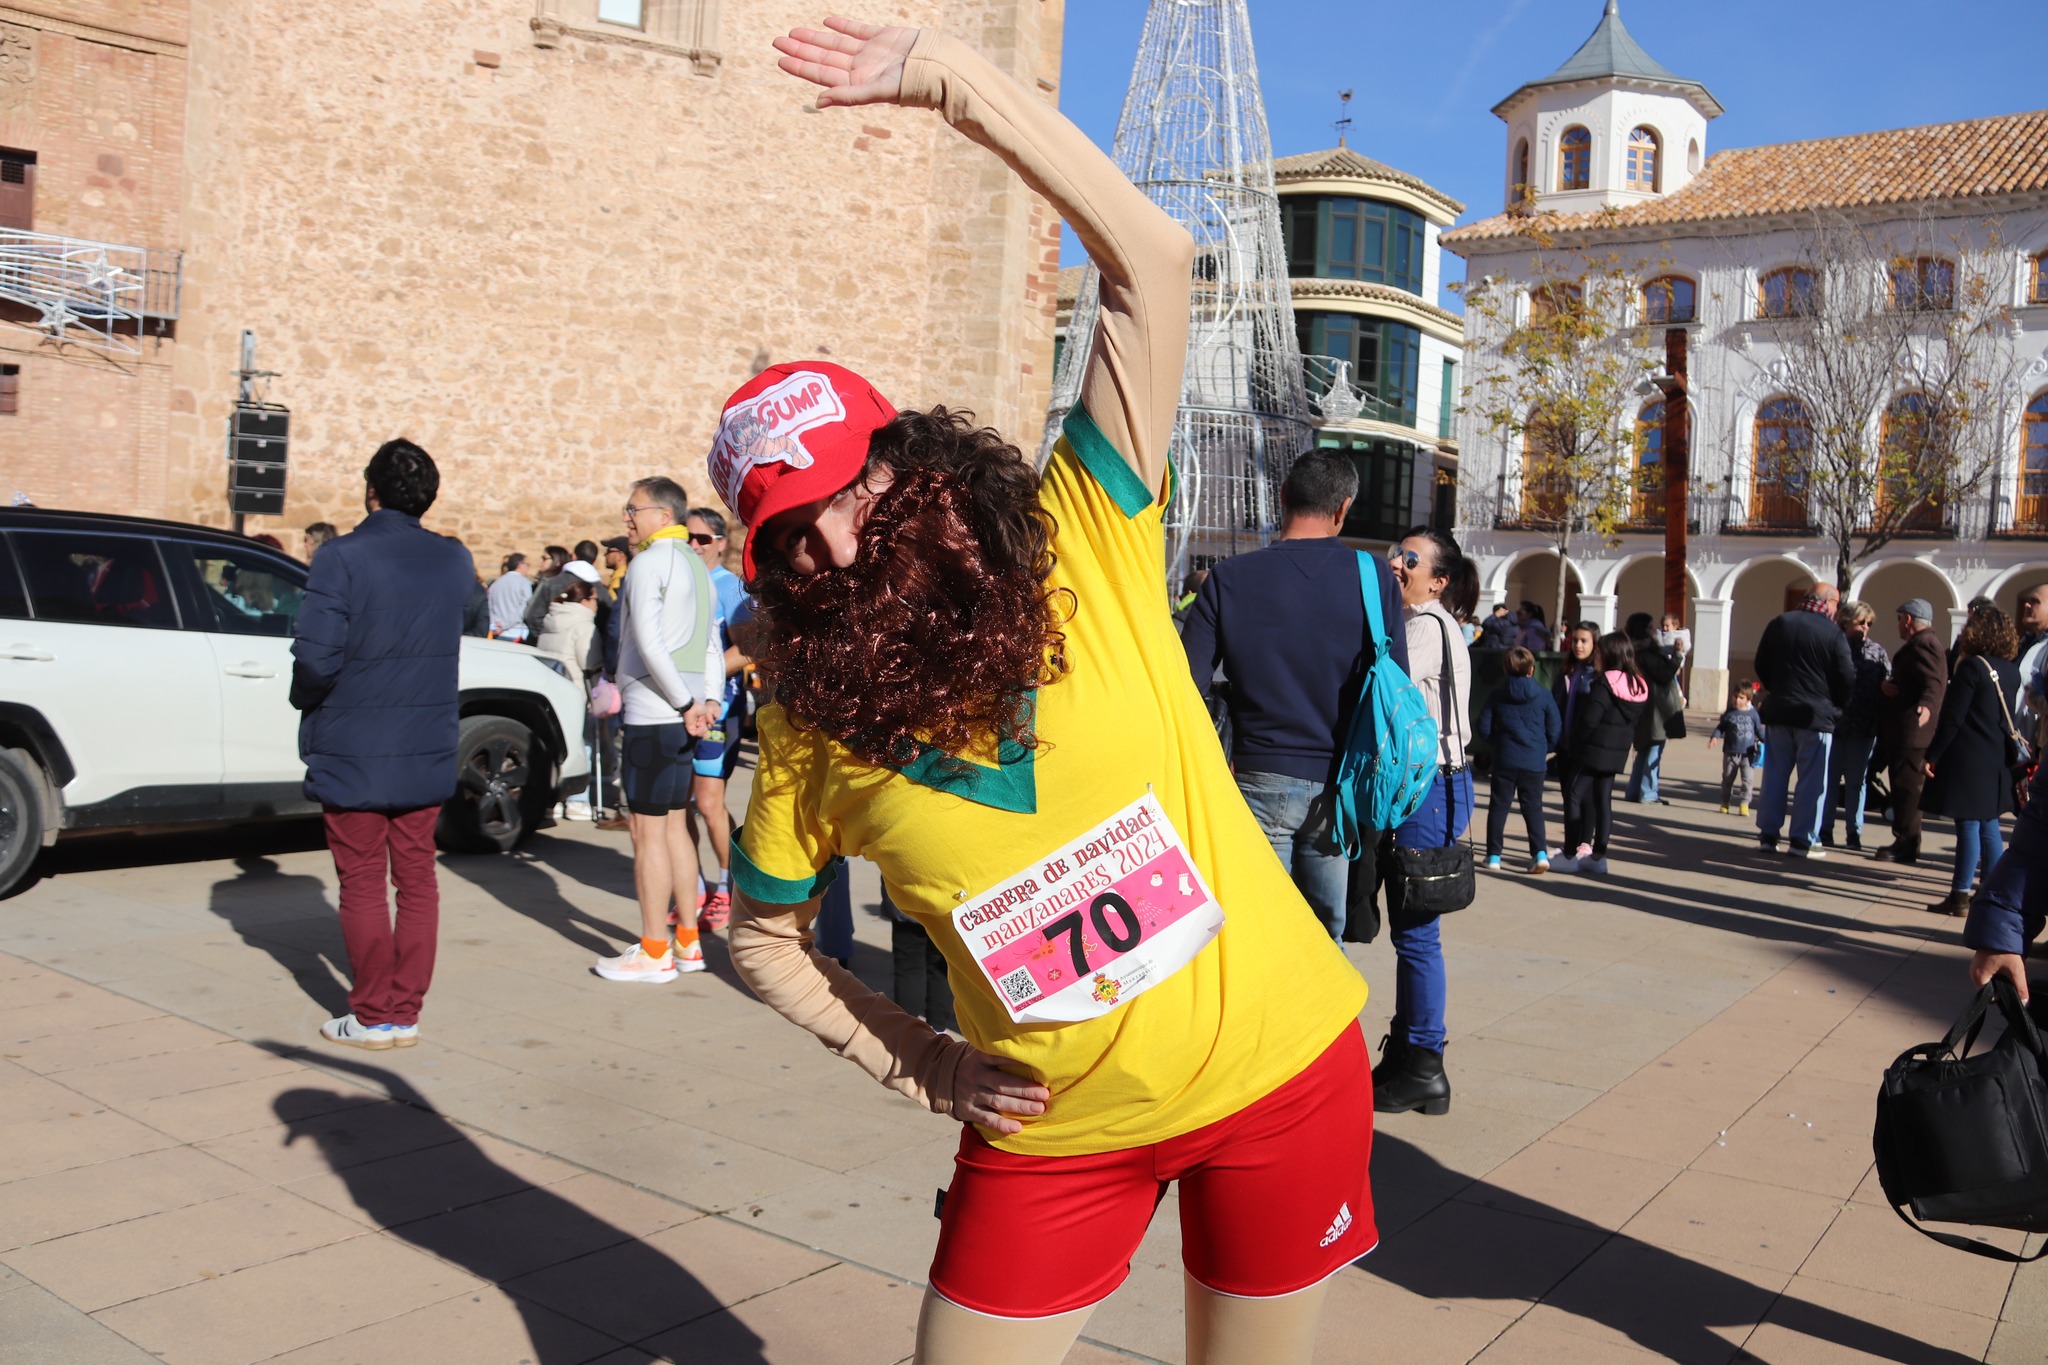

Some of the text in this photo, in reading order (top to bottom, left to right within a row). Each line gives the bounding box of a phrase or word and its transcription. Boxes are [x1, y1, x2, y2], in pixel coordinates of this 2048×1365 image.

[756, 382, 823, 430] GUMP
[1112, 825, 1170, 875] 2024
[1042, 892, 1142, 978] 70
[1319, 1215, 1352, 1247] adidas
